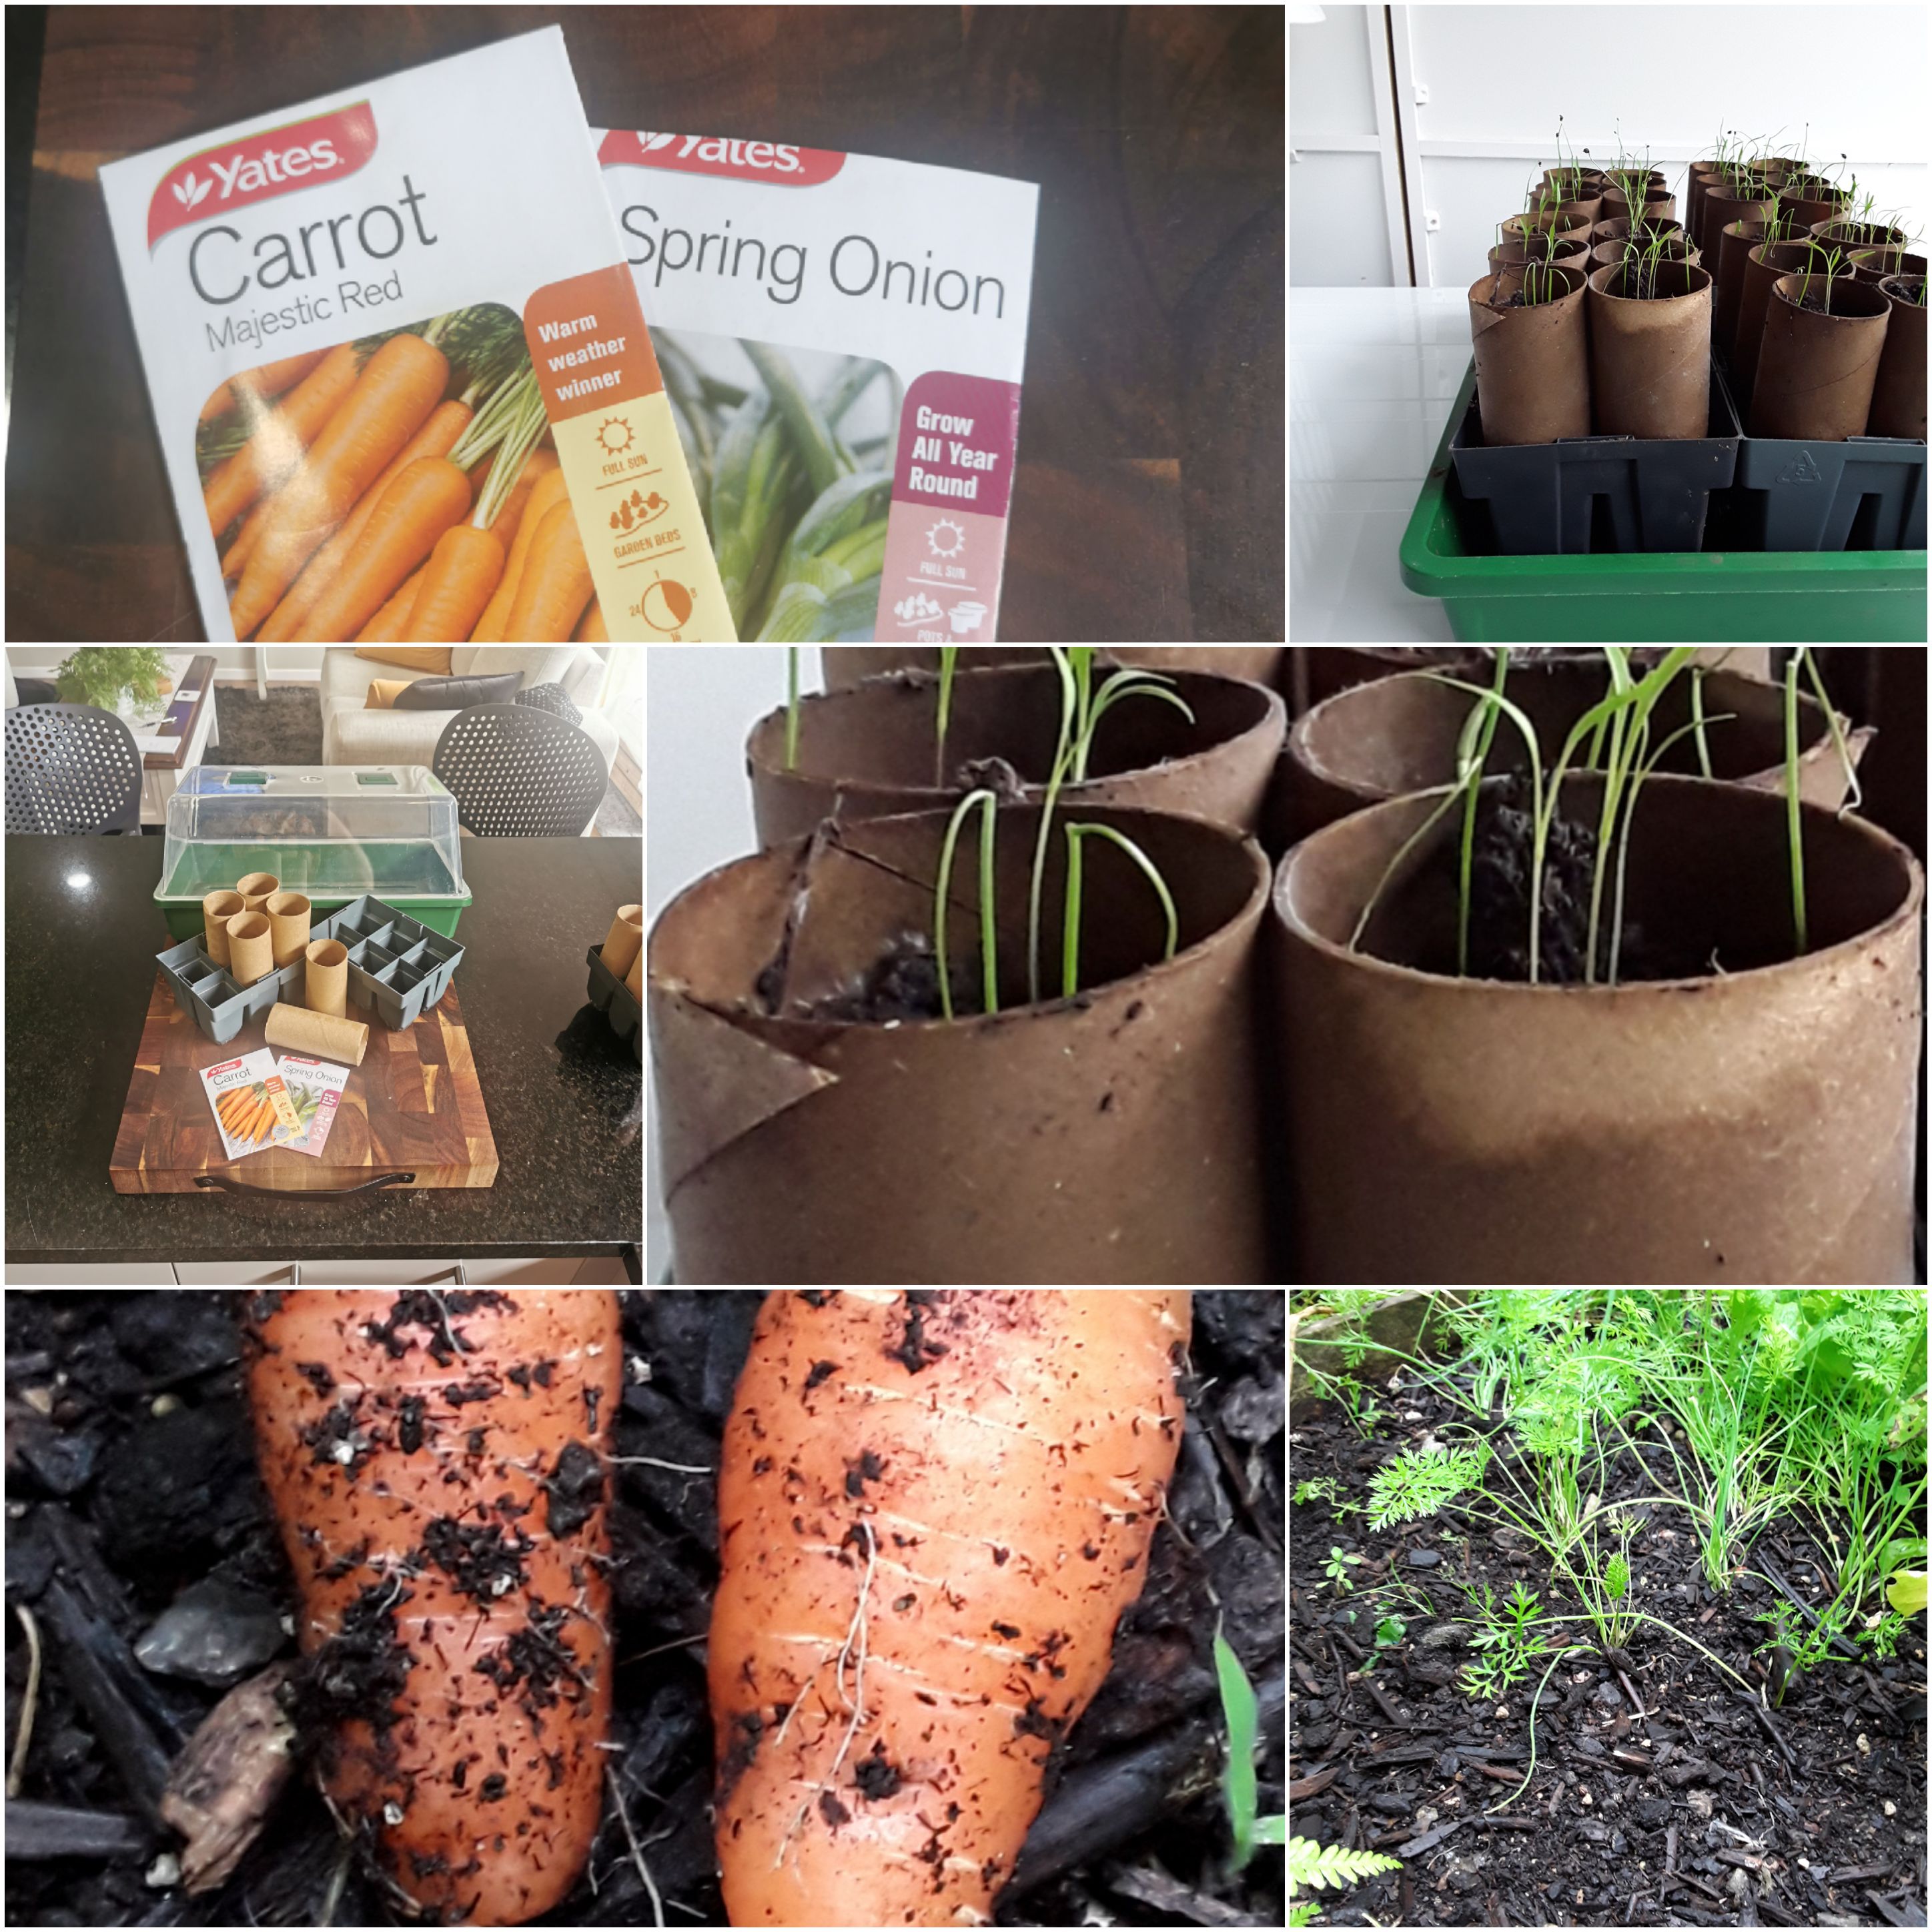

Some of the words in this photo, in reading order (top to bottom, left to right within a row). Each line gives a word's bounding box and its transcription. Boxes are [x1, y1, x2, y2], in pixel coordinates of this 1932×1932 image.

[209, 139, 336, 199] Yates
[189, 175, 438, 305] Carrot
[620, 205, 808, 304] Spring
[830, 235, 1006, 318] Onion
[206, 294, 332, 352] Majestic
[338, 271, 404, 314] Red
[538, 312, 598, 343] Warm
[548, 336, 626, 372] weather
[556, 368, 622, 402] winner
[917, 406, 973, 437] Grow
[602, 461, 625, 476] FULL
[628, 454, 648, 468] SUN
[912, 436, 941, 461] All
[948, 443, 999, 472] Year
[909, 468, 977, 500] Round
[614, 537, 652, 558] GARDEN
[654, 528, 681, 546] BEDS
[920, 561, 943, 576] FULL
[945, 565, 965, 580] SUN
[629, 604, 641, 617] 24
[917, 629, 943, 642] POTS
[213, 1067, 252, 1085] Carrot
[284, 1065, 313, 1079] Spring
[316, 1071, 342, 1083] Onion
